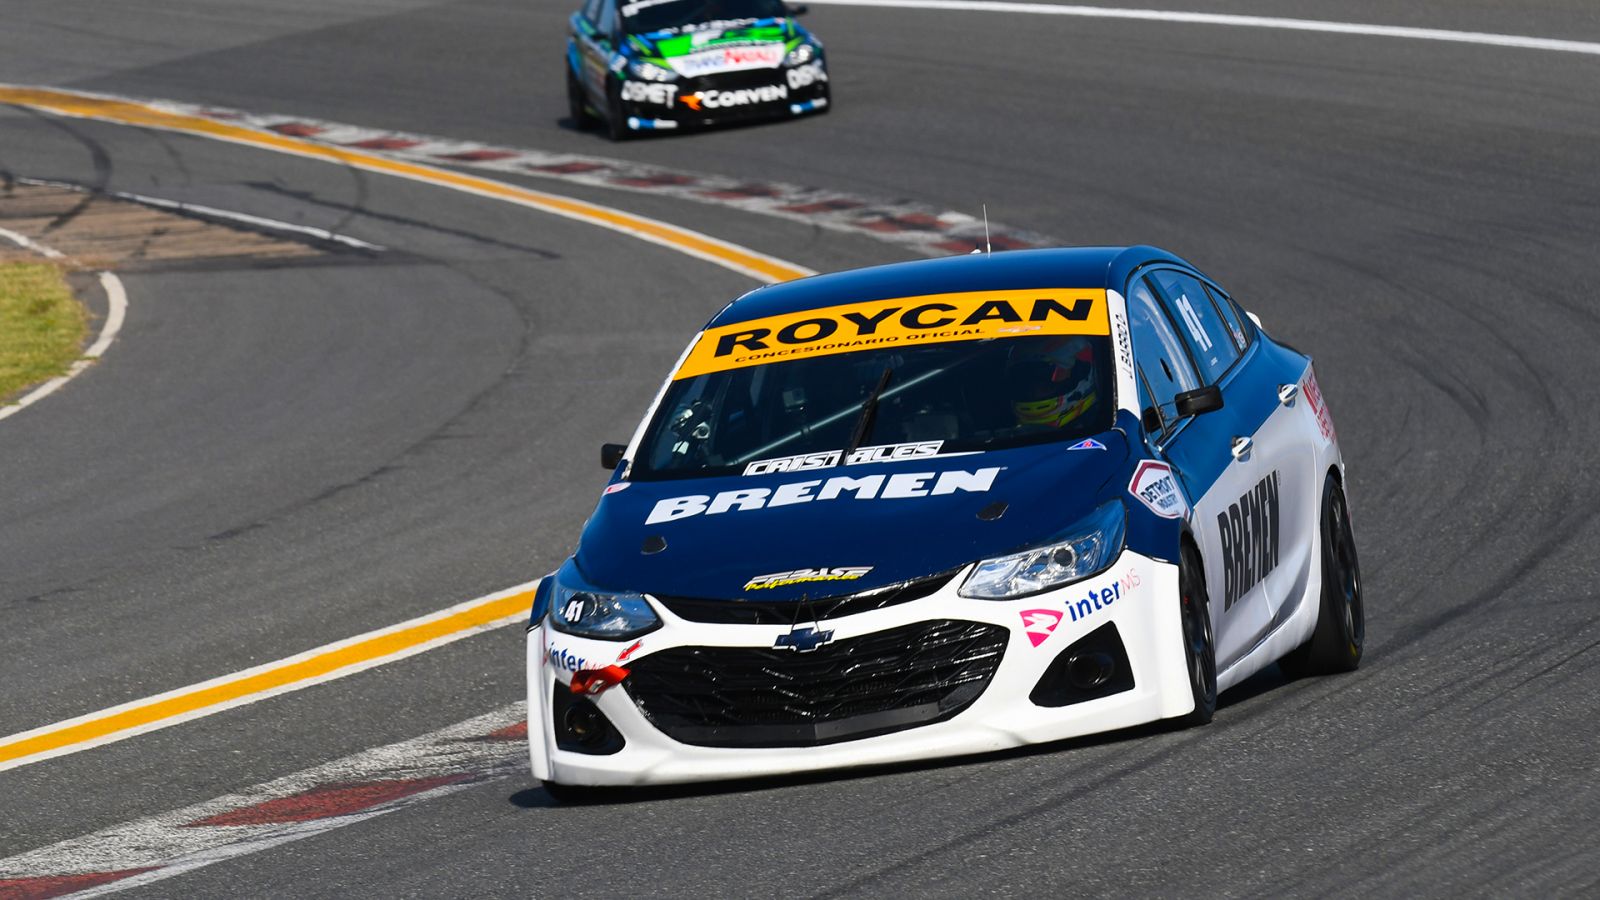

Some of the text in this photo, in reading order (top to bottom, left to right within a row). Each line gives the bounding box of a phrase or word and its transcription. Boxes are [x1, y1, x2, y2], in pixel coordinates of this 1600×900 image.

[702, 83, 788, 109] CORVEN
[714, 298, 1093, 358] ROYCAN
[735, 327, 986, 363] CONCESIONARIO OFICIAL
[1175, 293, 1213, 352] 41
[645, 467, 1000, 525] BREMEN
[1140, 475, 1175, 504] DETROIT
[1217, 470, 1280, 613] BREMEN
[565, 600, 585, 622] 41
